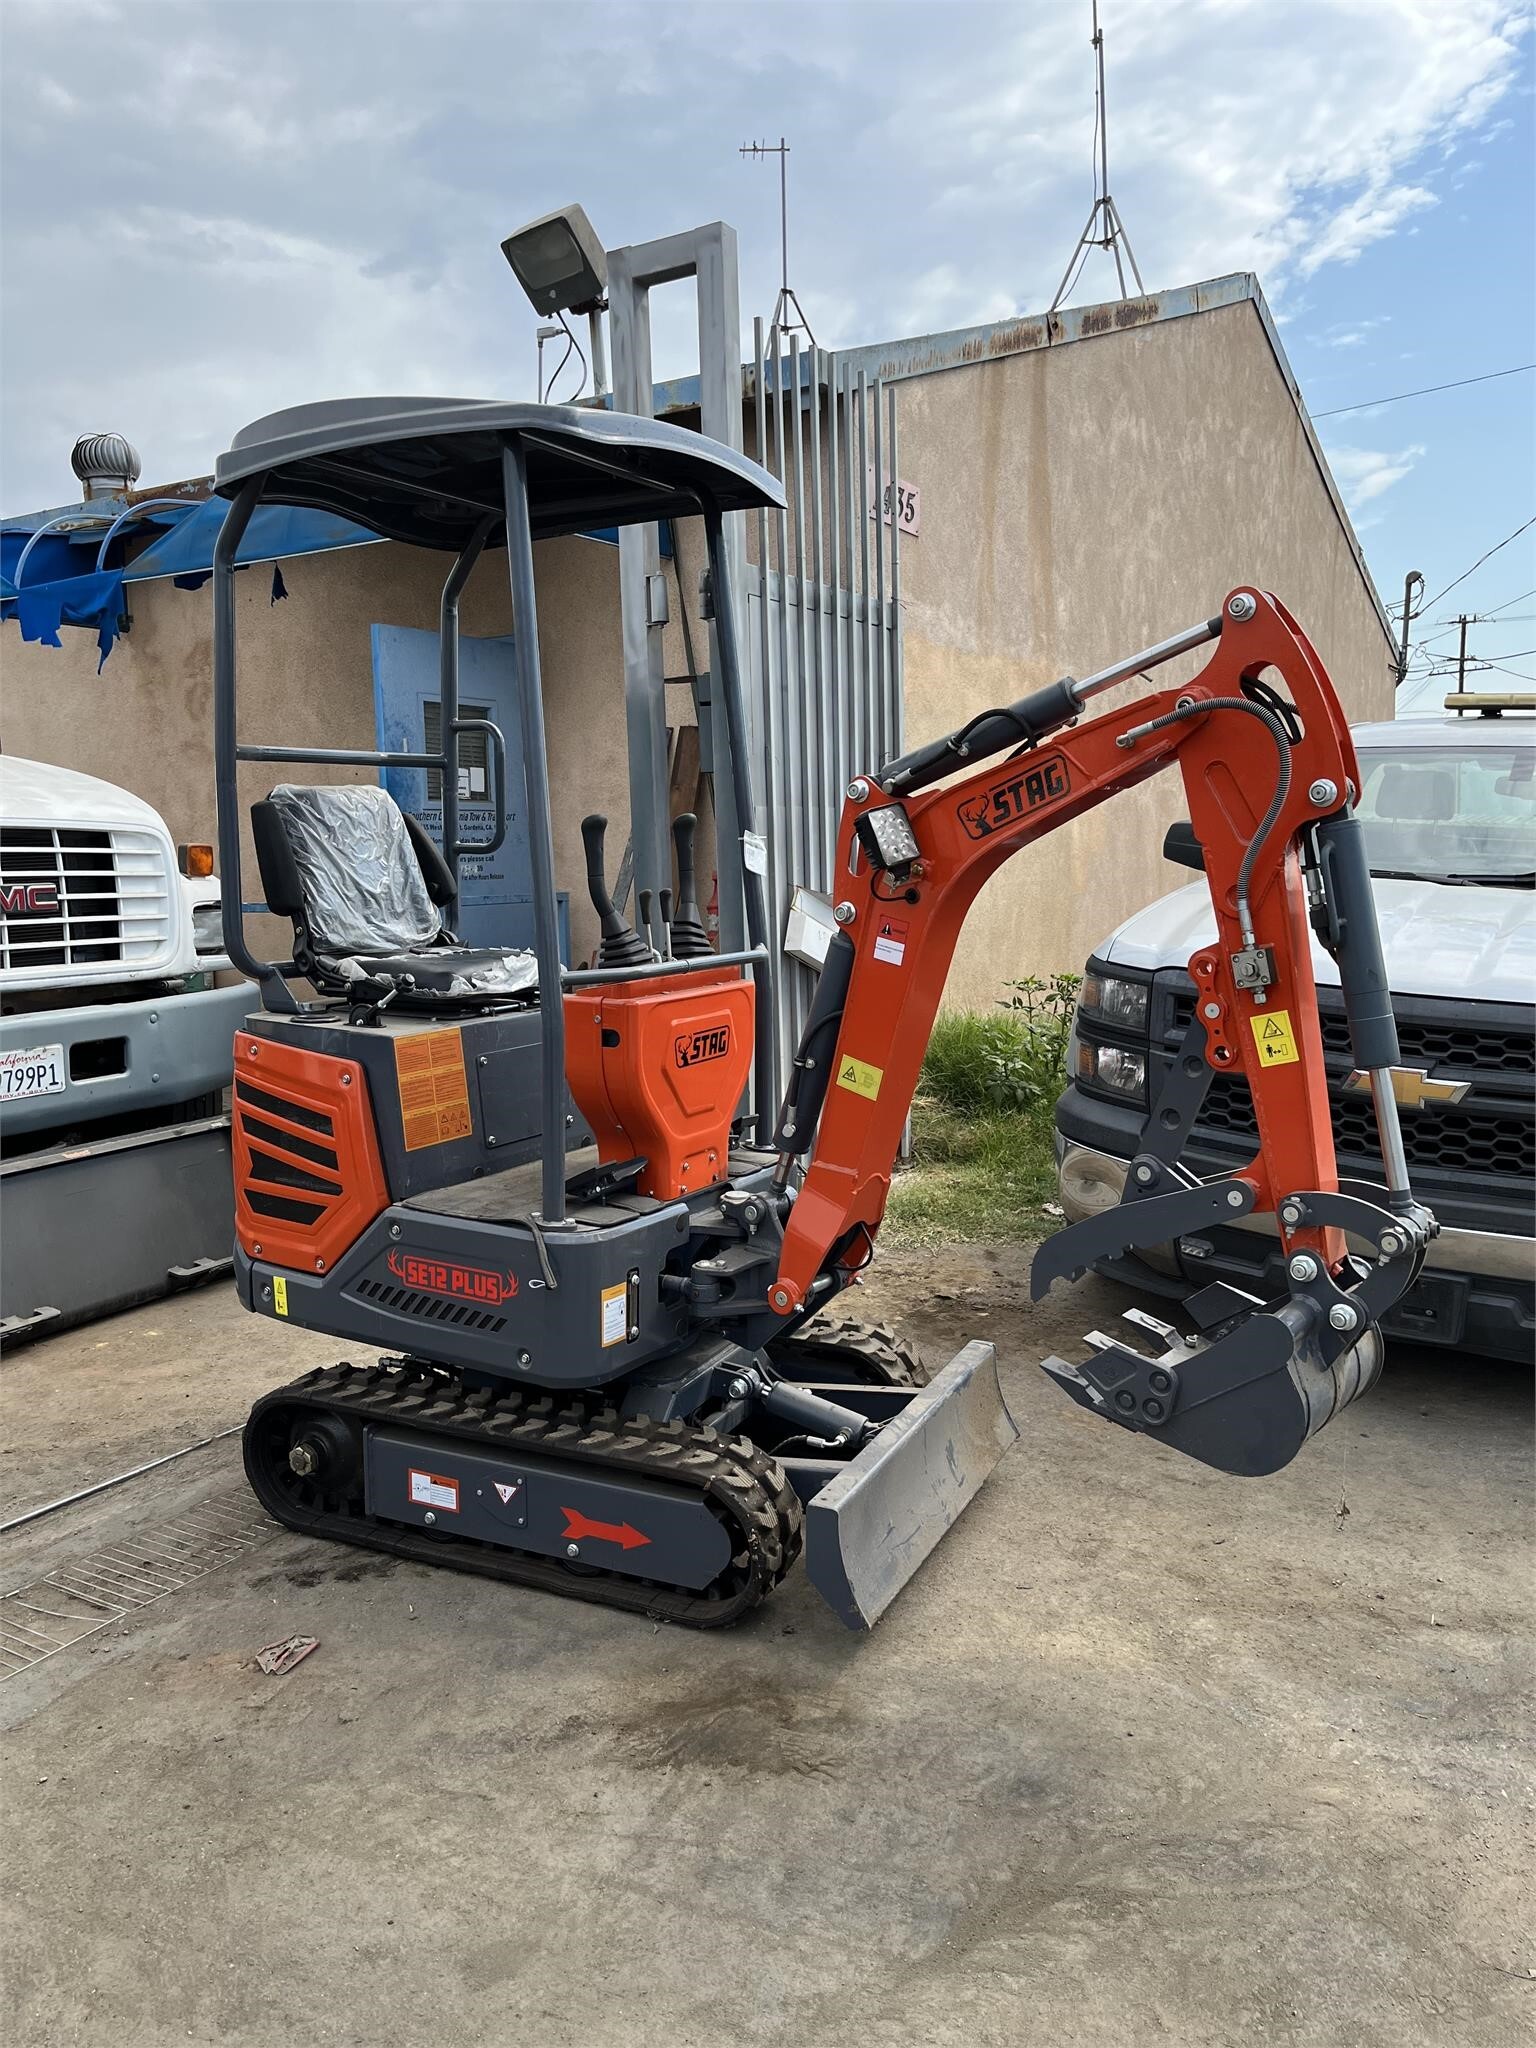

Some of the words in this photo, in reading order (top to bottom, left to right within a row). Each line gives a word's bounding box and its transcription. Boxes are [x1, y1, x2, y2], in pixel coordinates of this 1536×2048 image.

[993, 763, 1063, 824] STAG
[470, 812, 480, 821] Tow
[481, 812, 486, 821] &
[0, 885, 59, 912] MC
[690, 1029, 727, 1061] STAG
[0, 1053, 47, 1068] alifornia
[0, 1063, 59, 1093] 799P1
[407, 1261, 447, 1289] SE12
[451, 1269, 498, 1299] PLUS
